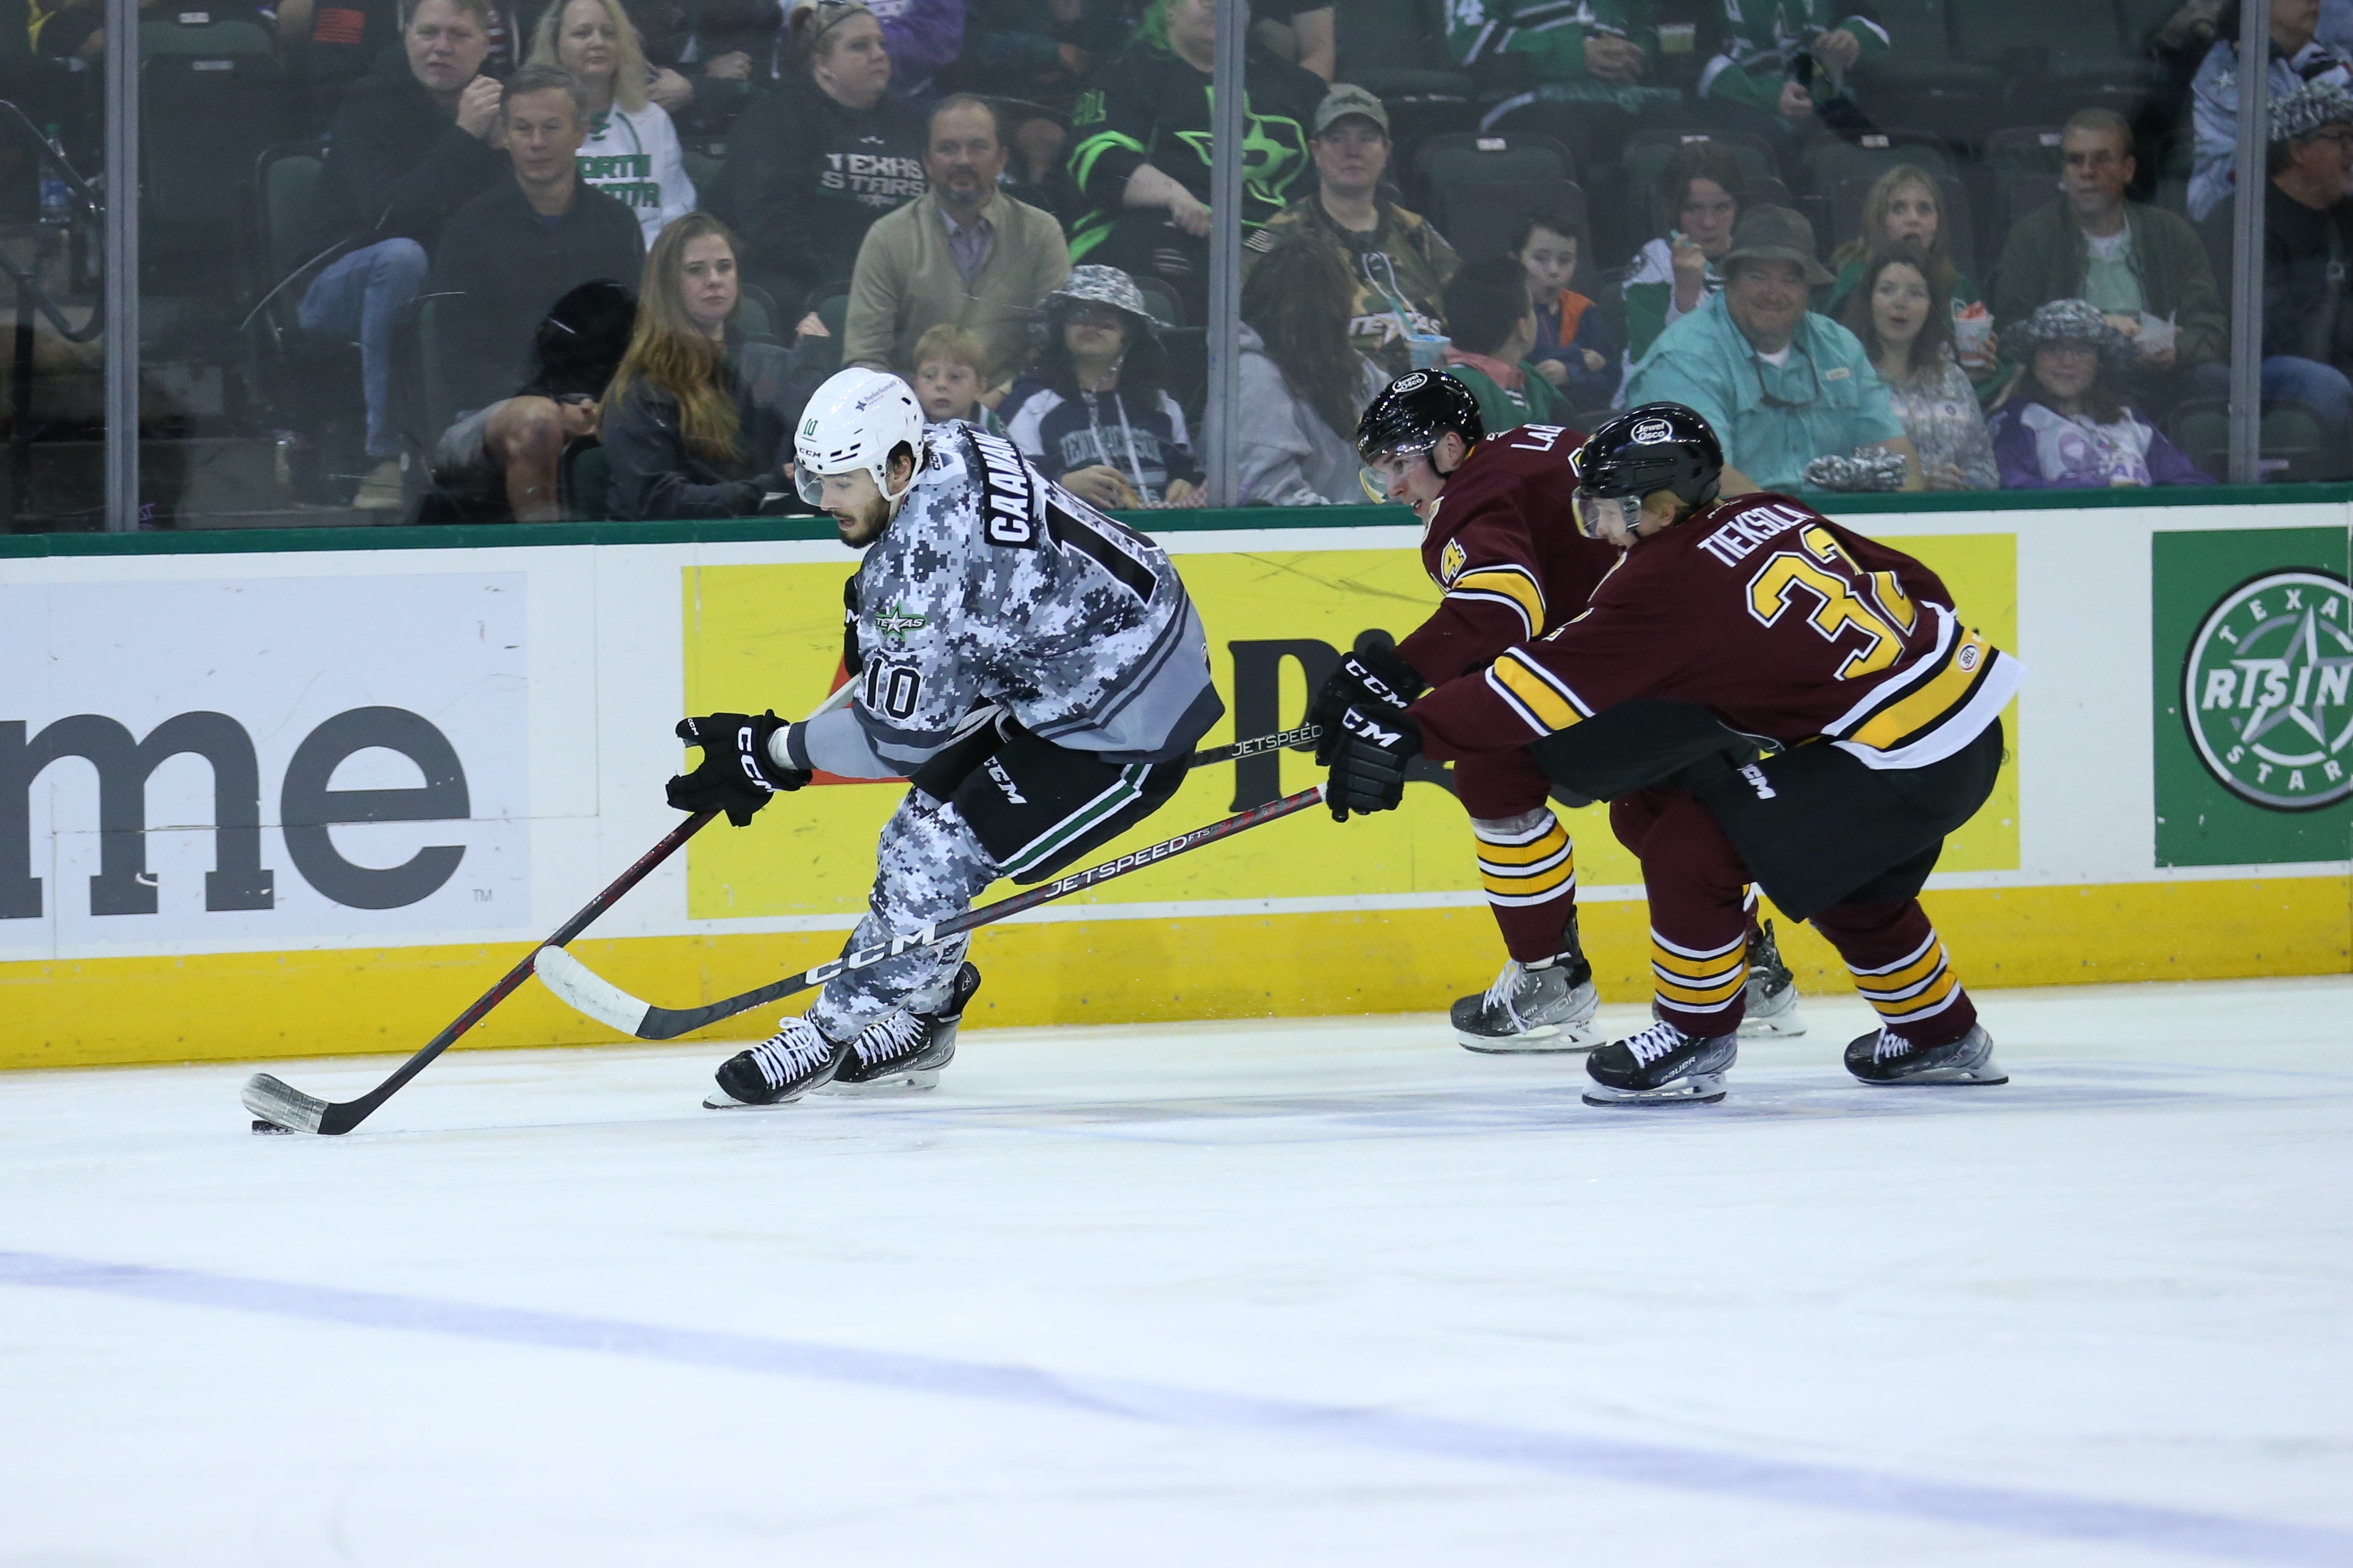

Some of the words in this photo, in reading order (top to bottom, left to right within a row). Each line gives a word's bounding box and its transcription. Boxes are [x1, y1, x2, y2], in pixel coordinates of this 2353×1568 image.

[575, 154, 650, 177] ORTH
[826, 153, 924, 181] TEXAS
[820, 171, 925, 197] STARS
[1396, 373, 1419, 388] Jewel
[1401, 378, 1423, 390] Osco
[803, 418, 818, 436] 10
[1636, 422, 1665, 434] Jewel
[1639, 431, 1665, 440] Osco
[799, 447, 821, 458] CCM
[1696, 504, 1813, 568] TIEKSOLA
[1746, 523, 1917, 682] 32
[876, 611, 925, 632] TEXAS
[865, 656, 922, 722] 10
[1345, 659, 1408, 709] CCM
[687, 718, 700, 736] CCM
[1232, 725, 1323, 757] JETSPEED
[1343, 707, 1402, 747] CM
[738, 726, 783, 792] CCM
[984, 755, 1028, 804] CCM
[0, 705, 471, 918] me
[1045, 835, 1188, 898] JETSPEED
[1188, 827, 1210, 842] FTS
[805, 924, 936, 986] CCM
